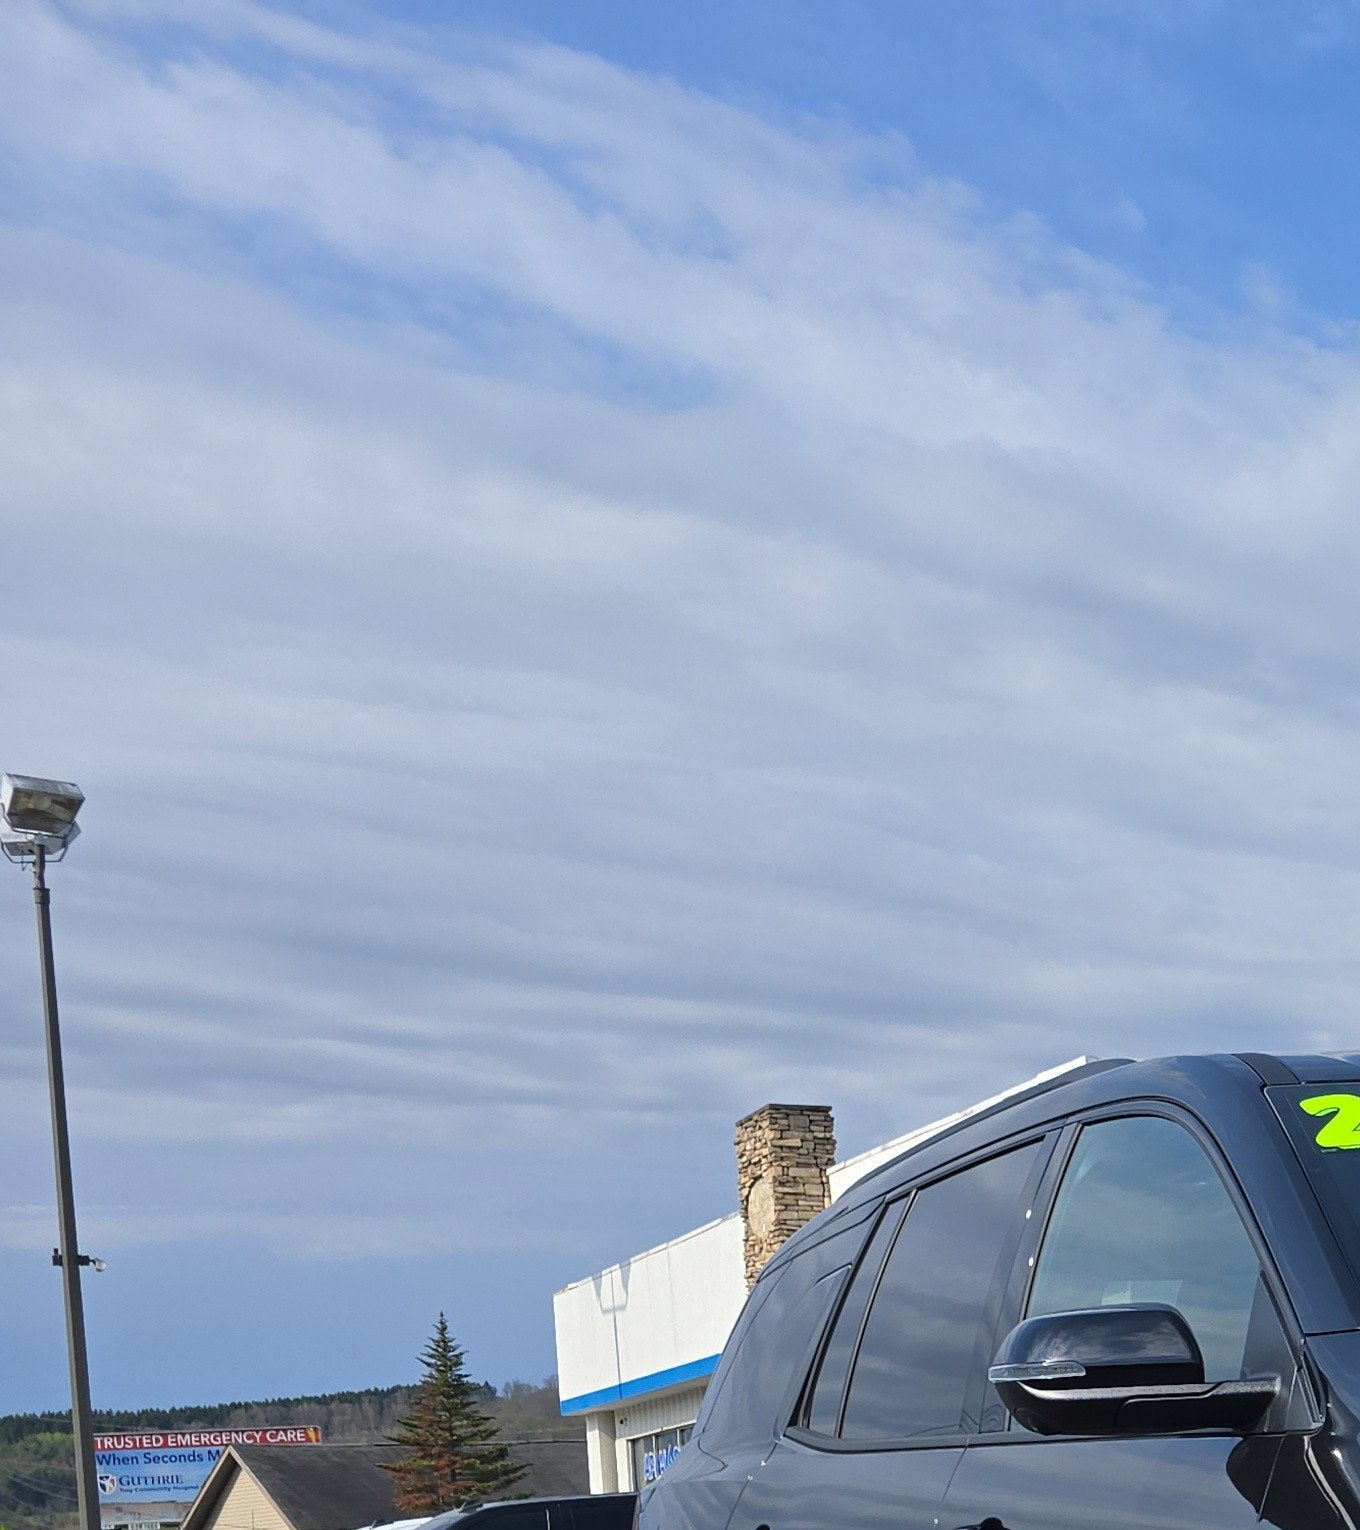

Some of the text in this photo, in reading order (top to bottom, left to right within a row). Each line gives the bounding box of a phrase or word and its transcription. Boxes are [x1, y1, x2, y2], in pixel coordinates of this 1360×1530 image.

[94, 1428, 306, 1450] TRUSTED EMERGENCY CARE
[96, 1452, 139, 1467] When
[144, 1450, 203, 1465] Seconds
[119, 1474, 184, 1487] GUTHRIE
